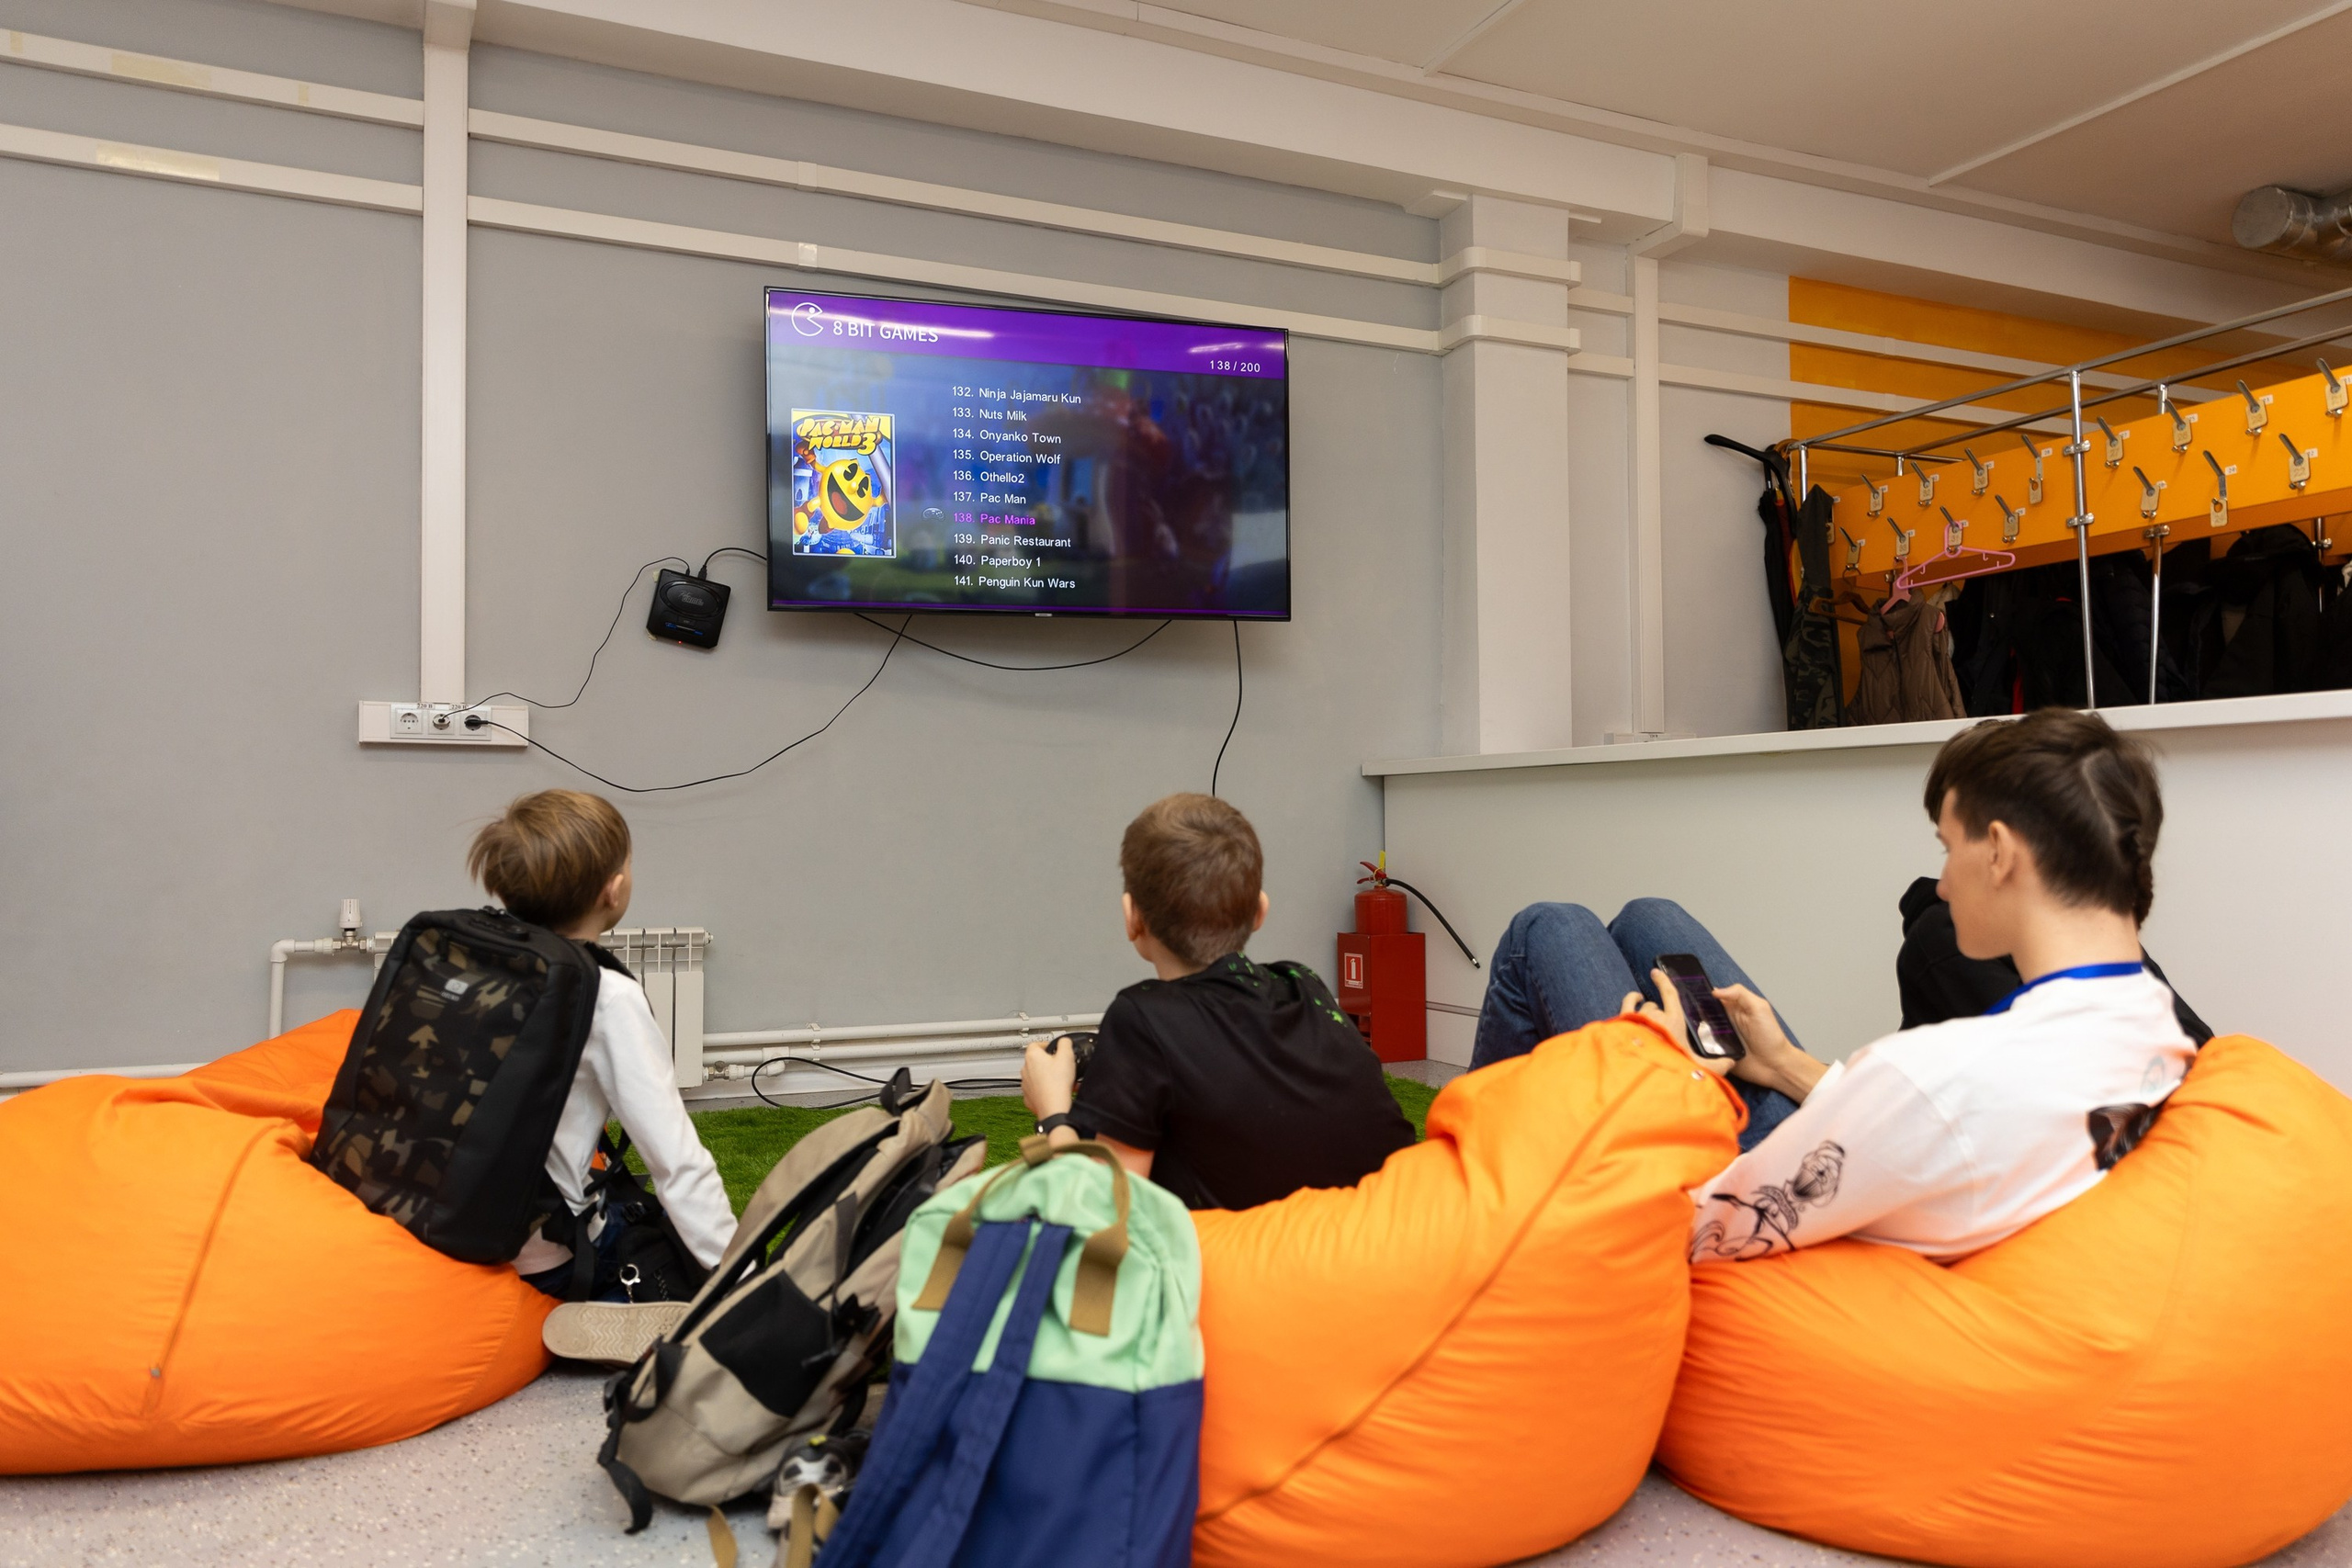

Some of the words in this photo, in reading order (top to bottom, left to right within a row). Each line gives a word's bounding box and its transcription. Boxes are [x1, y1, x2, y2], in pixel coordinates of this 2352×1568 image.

[833, 321, 843, 335] 8
[848, 322, 875, 337] BIT
[880, 324, 939, 342] GAMES
[952, 386, 974, 397] 132.
[979, 388, 1006, 401] Ninja
[1011, 390, 1058, 403] Jajamaru
[1061, 394, 1081, 404] Kun
[952, 408, 974, 418] 133.
[979, 409, 1003, 419] Nuts
[1007, 411, 1027, 421] Milk
[953, 428, 974, 439] 134.
[980, 430, 1028, 442] Onyanko
[1032, 433, 1061, 443] Town
[809, 435, 862, 450] WORLD
[857, 433, 876, 455] 3
[953, 449, 974, 460] 135.
[980, 451, 1032, 463] Operation
[1036, 454, 1061, 464] Wolf
[953, 471, 974, 481] 136.
[980, 472, 1025, 483] Othello2
[953, 492, 975, 502] 137.
[981, 493, 1000, 503] Pac
[1005, 494, 1026, 504] Man
[954, 513, 975, 523] 138.
[981, 514, 1001, 524] Pac
[1005, 515, 1036, 525] Mania
[954, 534, 975, 544] 139.
[981, 534, 1010, 545] Panic
[1014, 536, 1071, 547] Restaurant
[954, 555, 975, 565] 140.
[981, 556, 1032, 569] Paperboy
[1036, 557, 1041, 567] 1
[954, 576, 973, 586] 141.
[979, 577, 1020, 589] Penguin
[1024, 578, 1044, 587] Kun
[1048, 578, 1075, 588] Wars
